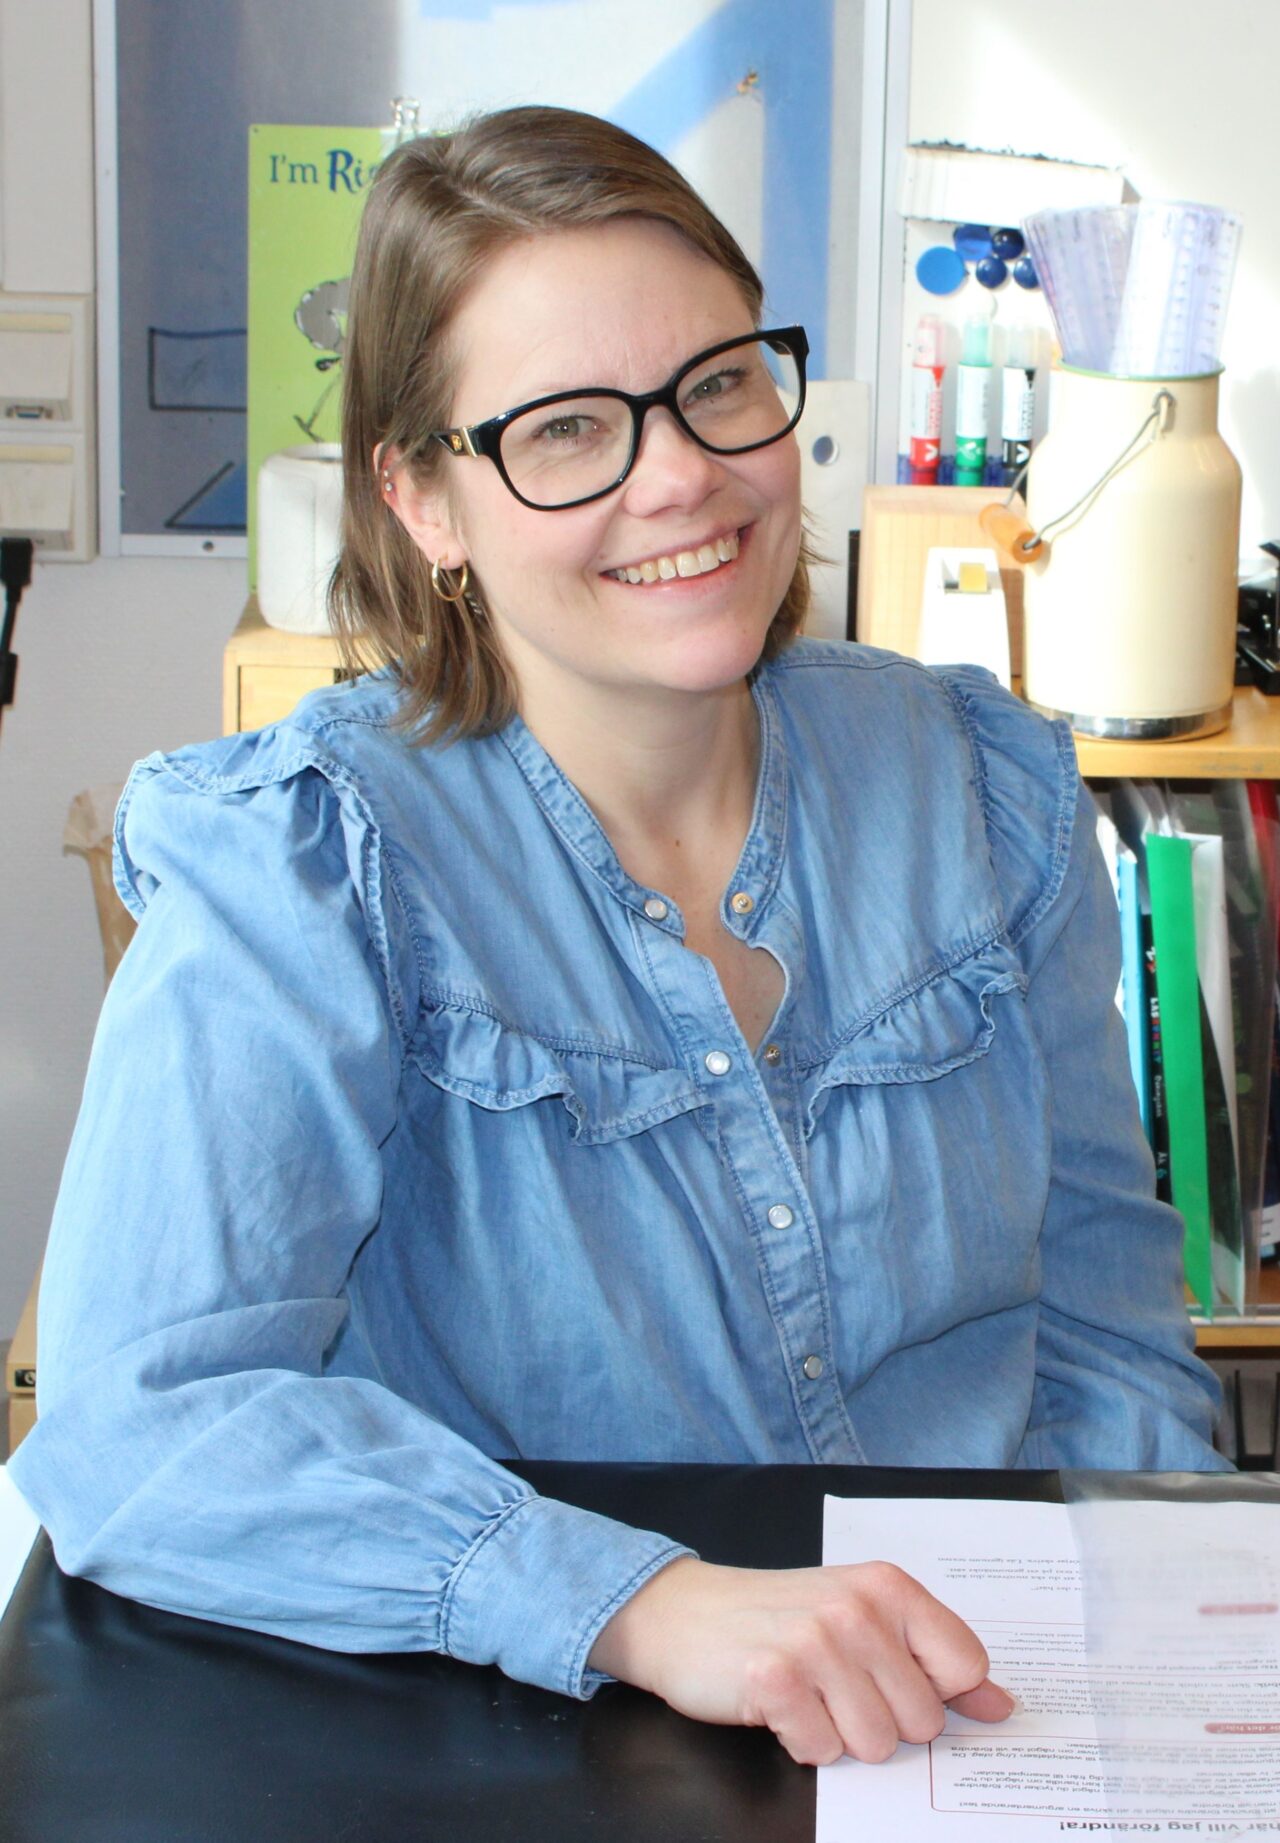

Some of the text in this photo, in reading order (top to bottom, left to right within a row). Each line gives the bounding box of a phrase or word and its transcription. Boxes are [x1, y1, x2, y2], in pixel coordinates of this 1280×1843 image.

[270, 154, 318, 184] I'm
[1060, 1821, 1160, 1832] förändra!
[1168, 1822, 1200, 1832] jag
[1208, 1823, 1239, 1832] vill
[1247, 1822, 1280, 1832] här
